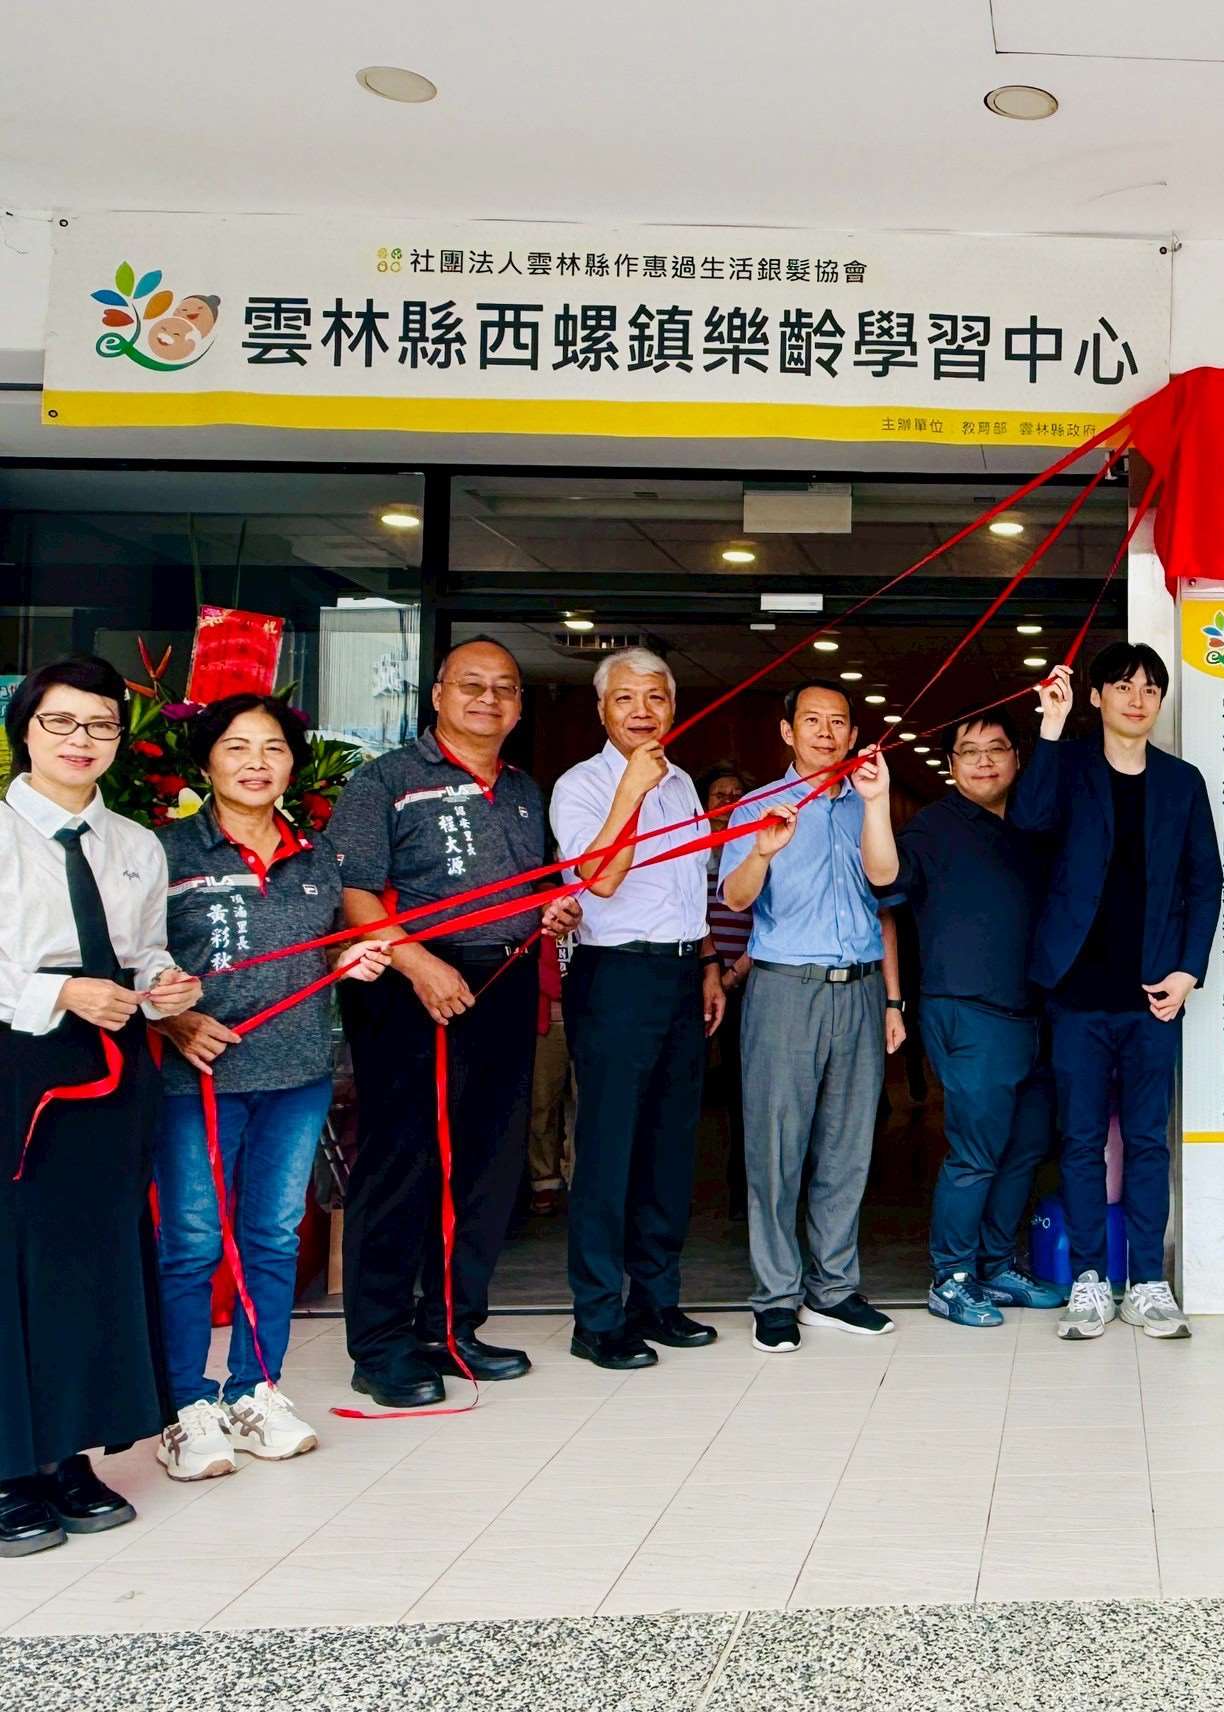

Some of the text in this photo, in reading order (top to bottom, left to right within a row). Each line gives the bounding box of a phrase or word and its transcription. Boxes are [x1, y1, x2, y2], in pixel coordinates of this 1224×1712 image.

[409, 248, 868, 285] 社團法人雲林縣作惠過生活銀髮協會
[240, 295, 1140, 386] 雲林縣西螺鎮樂齡學習中心
